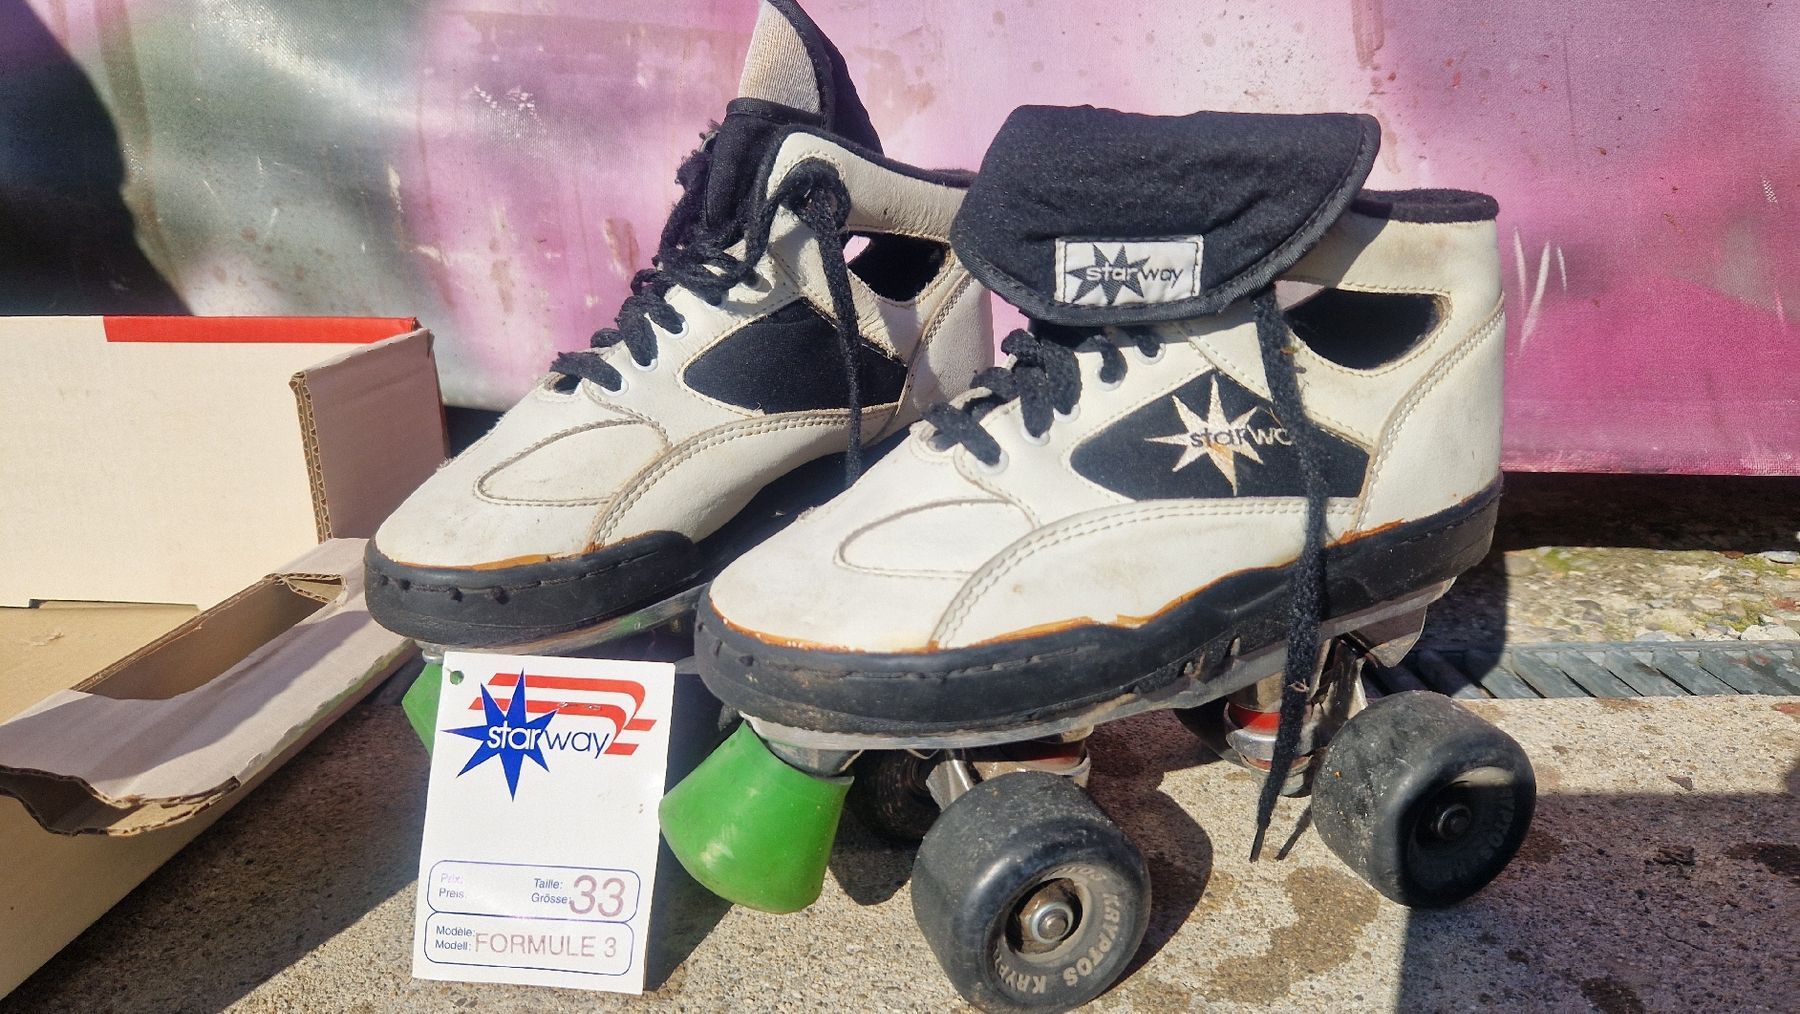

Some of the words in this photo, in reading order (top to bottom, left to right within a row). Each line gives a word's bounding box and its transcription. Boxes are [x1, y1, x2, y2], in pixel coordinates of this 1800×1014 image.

[1085, 262, 1184, 289] starway
[1189, 424, 1293, 448] starwa
[486, 720, 610, 759] starway
[533, 877, 564, 890] Taille:
[569, 874, 626, 918] 33
[436, 925, 476, 938] Modèle:
[435, 940, 472, 952] Modell:
[474, 932, 597, 958] FORMULE
[603, 936, 617, 959] 3
